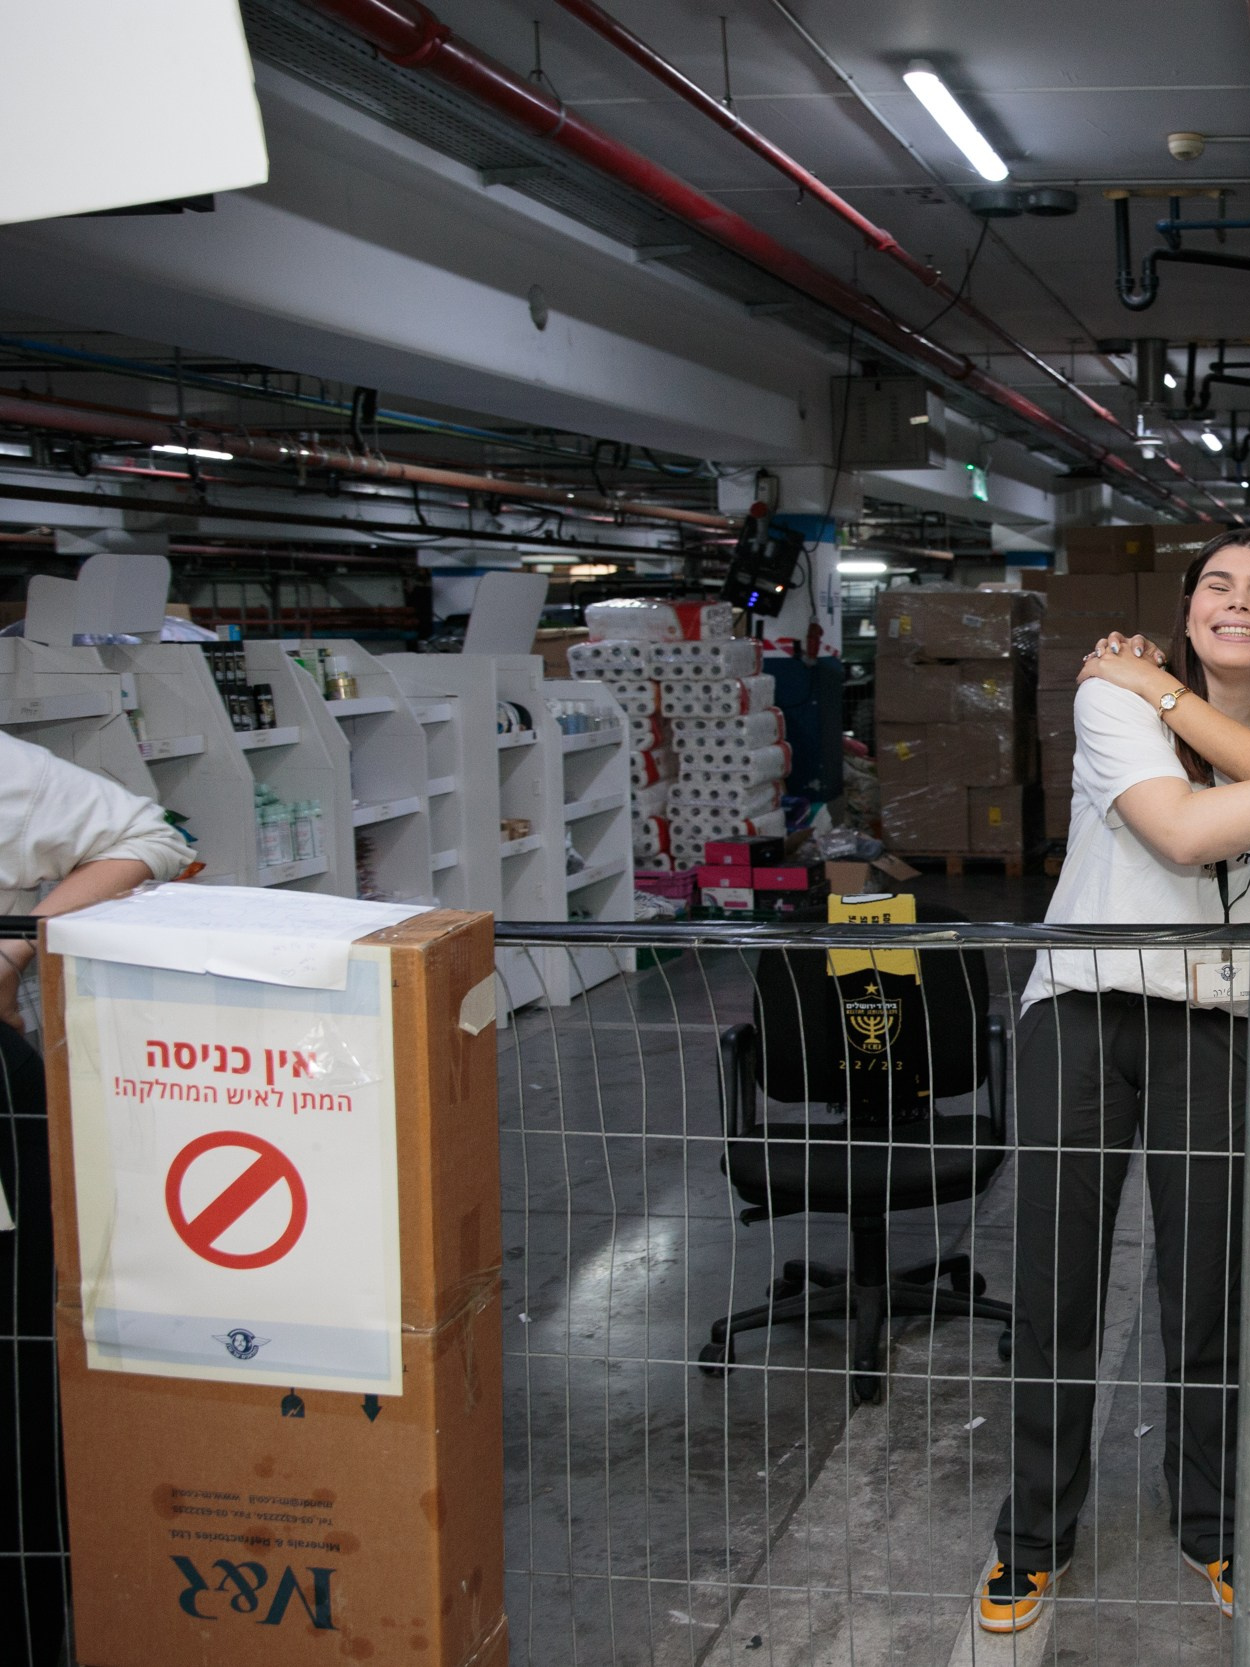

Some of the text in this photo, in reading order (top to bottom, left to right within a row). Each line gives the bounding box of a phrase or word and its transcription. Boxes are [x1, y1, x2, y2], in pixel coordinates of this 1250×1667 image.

[146, 1040, 317, 1086] אין כניסה
[114, 1077, 352, 1115] המתן לאיש המחלקה!
[168, 1528, 341, 1552] Minerals & Refractories Ltd.
[169, 1555, 341, 1631] M&R
